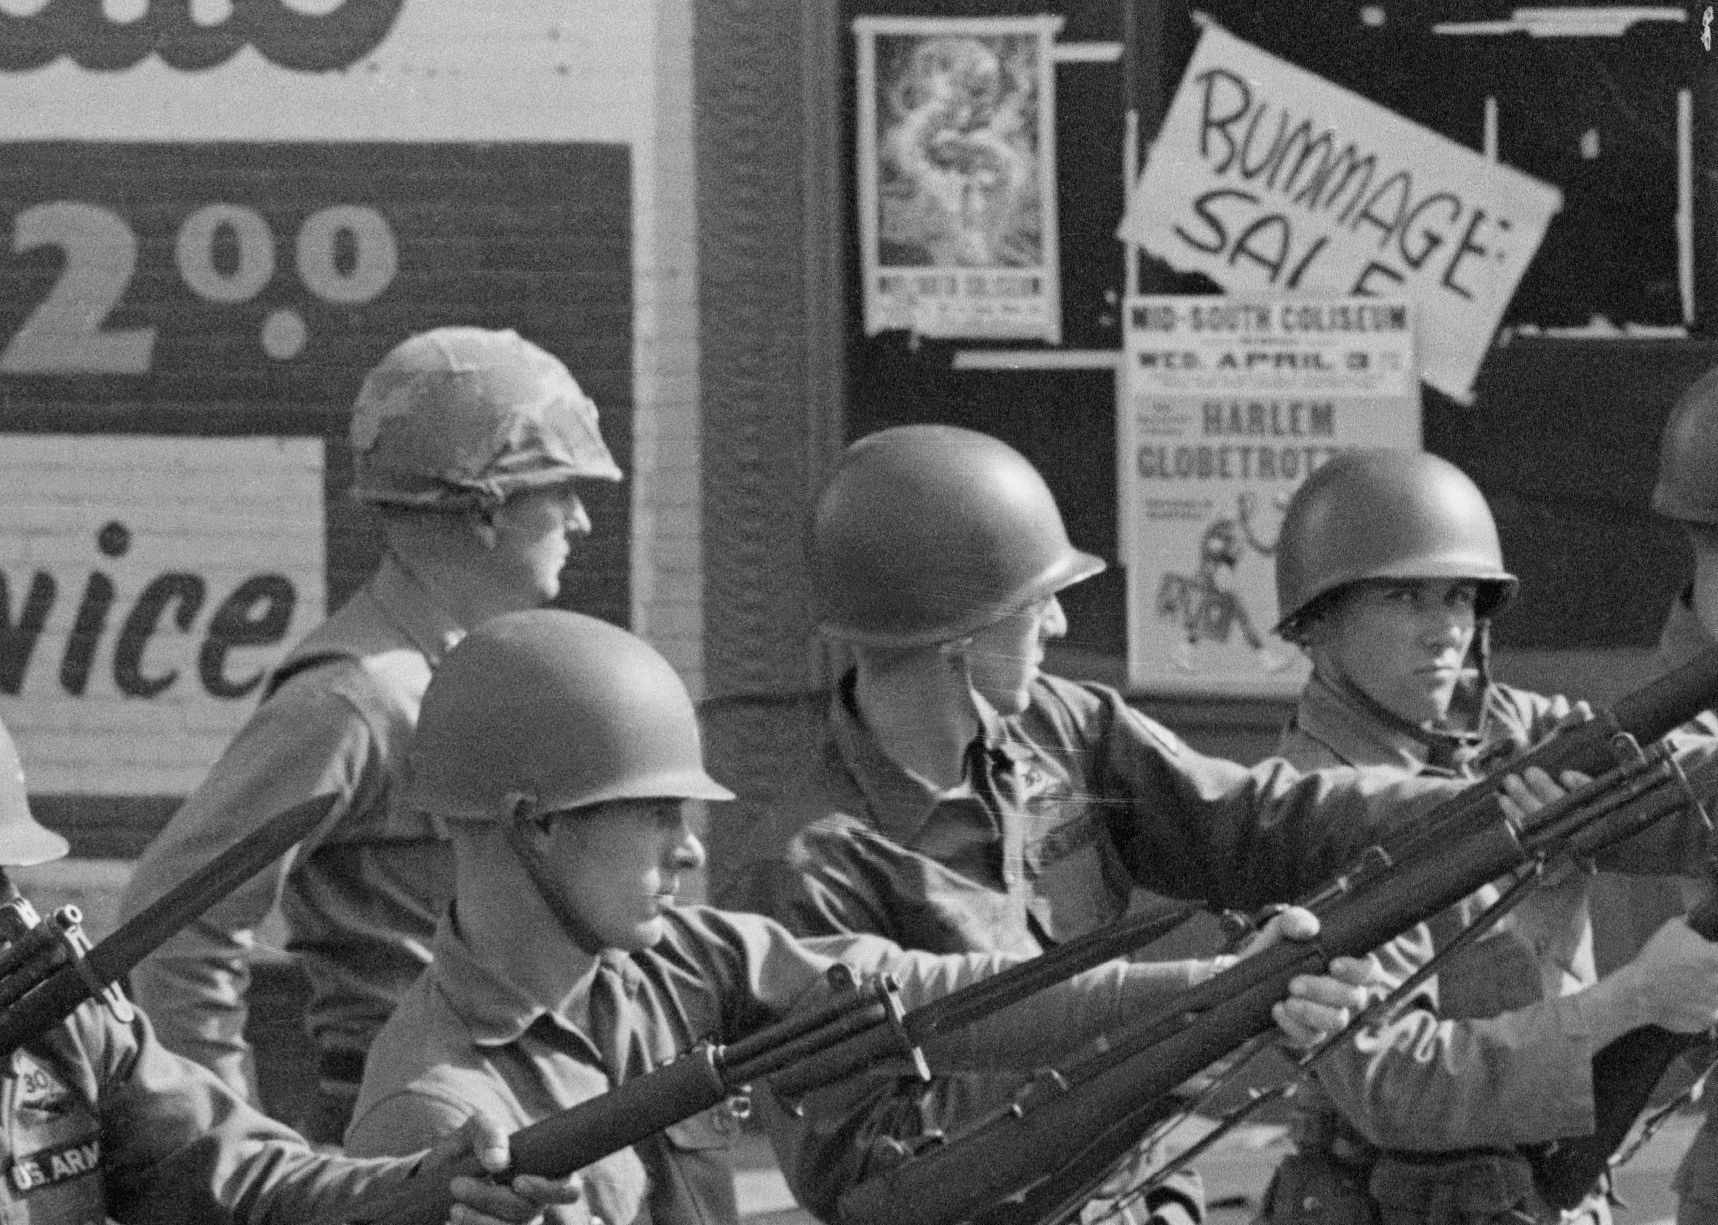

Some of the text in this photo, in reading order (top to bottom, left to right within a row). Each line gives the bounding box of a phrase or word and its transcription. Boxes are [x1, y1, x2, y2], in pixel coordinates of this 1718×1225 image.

[1132, 304, 1407, 334] MID-SOUTH COLISEUM
[1217, 351, 1333, 372] APRIL
[1202, 400, 1335, 438] HARLEM
[51, 1139, 100, 1180] ARM
